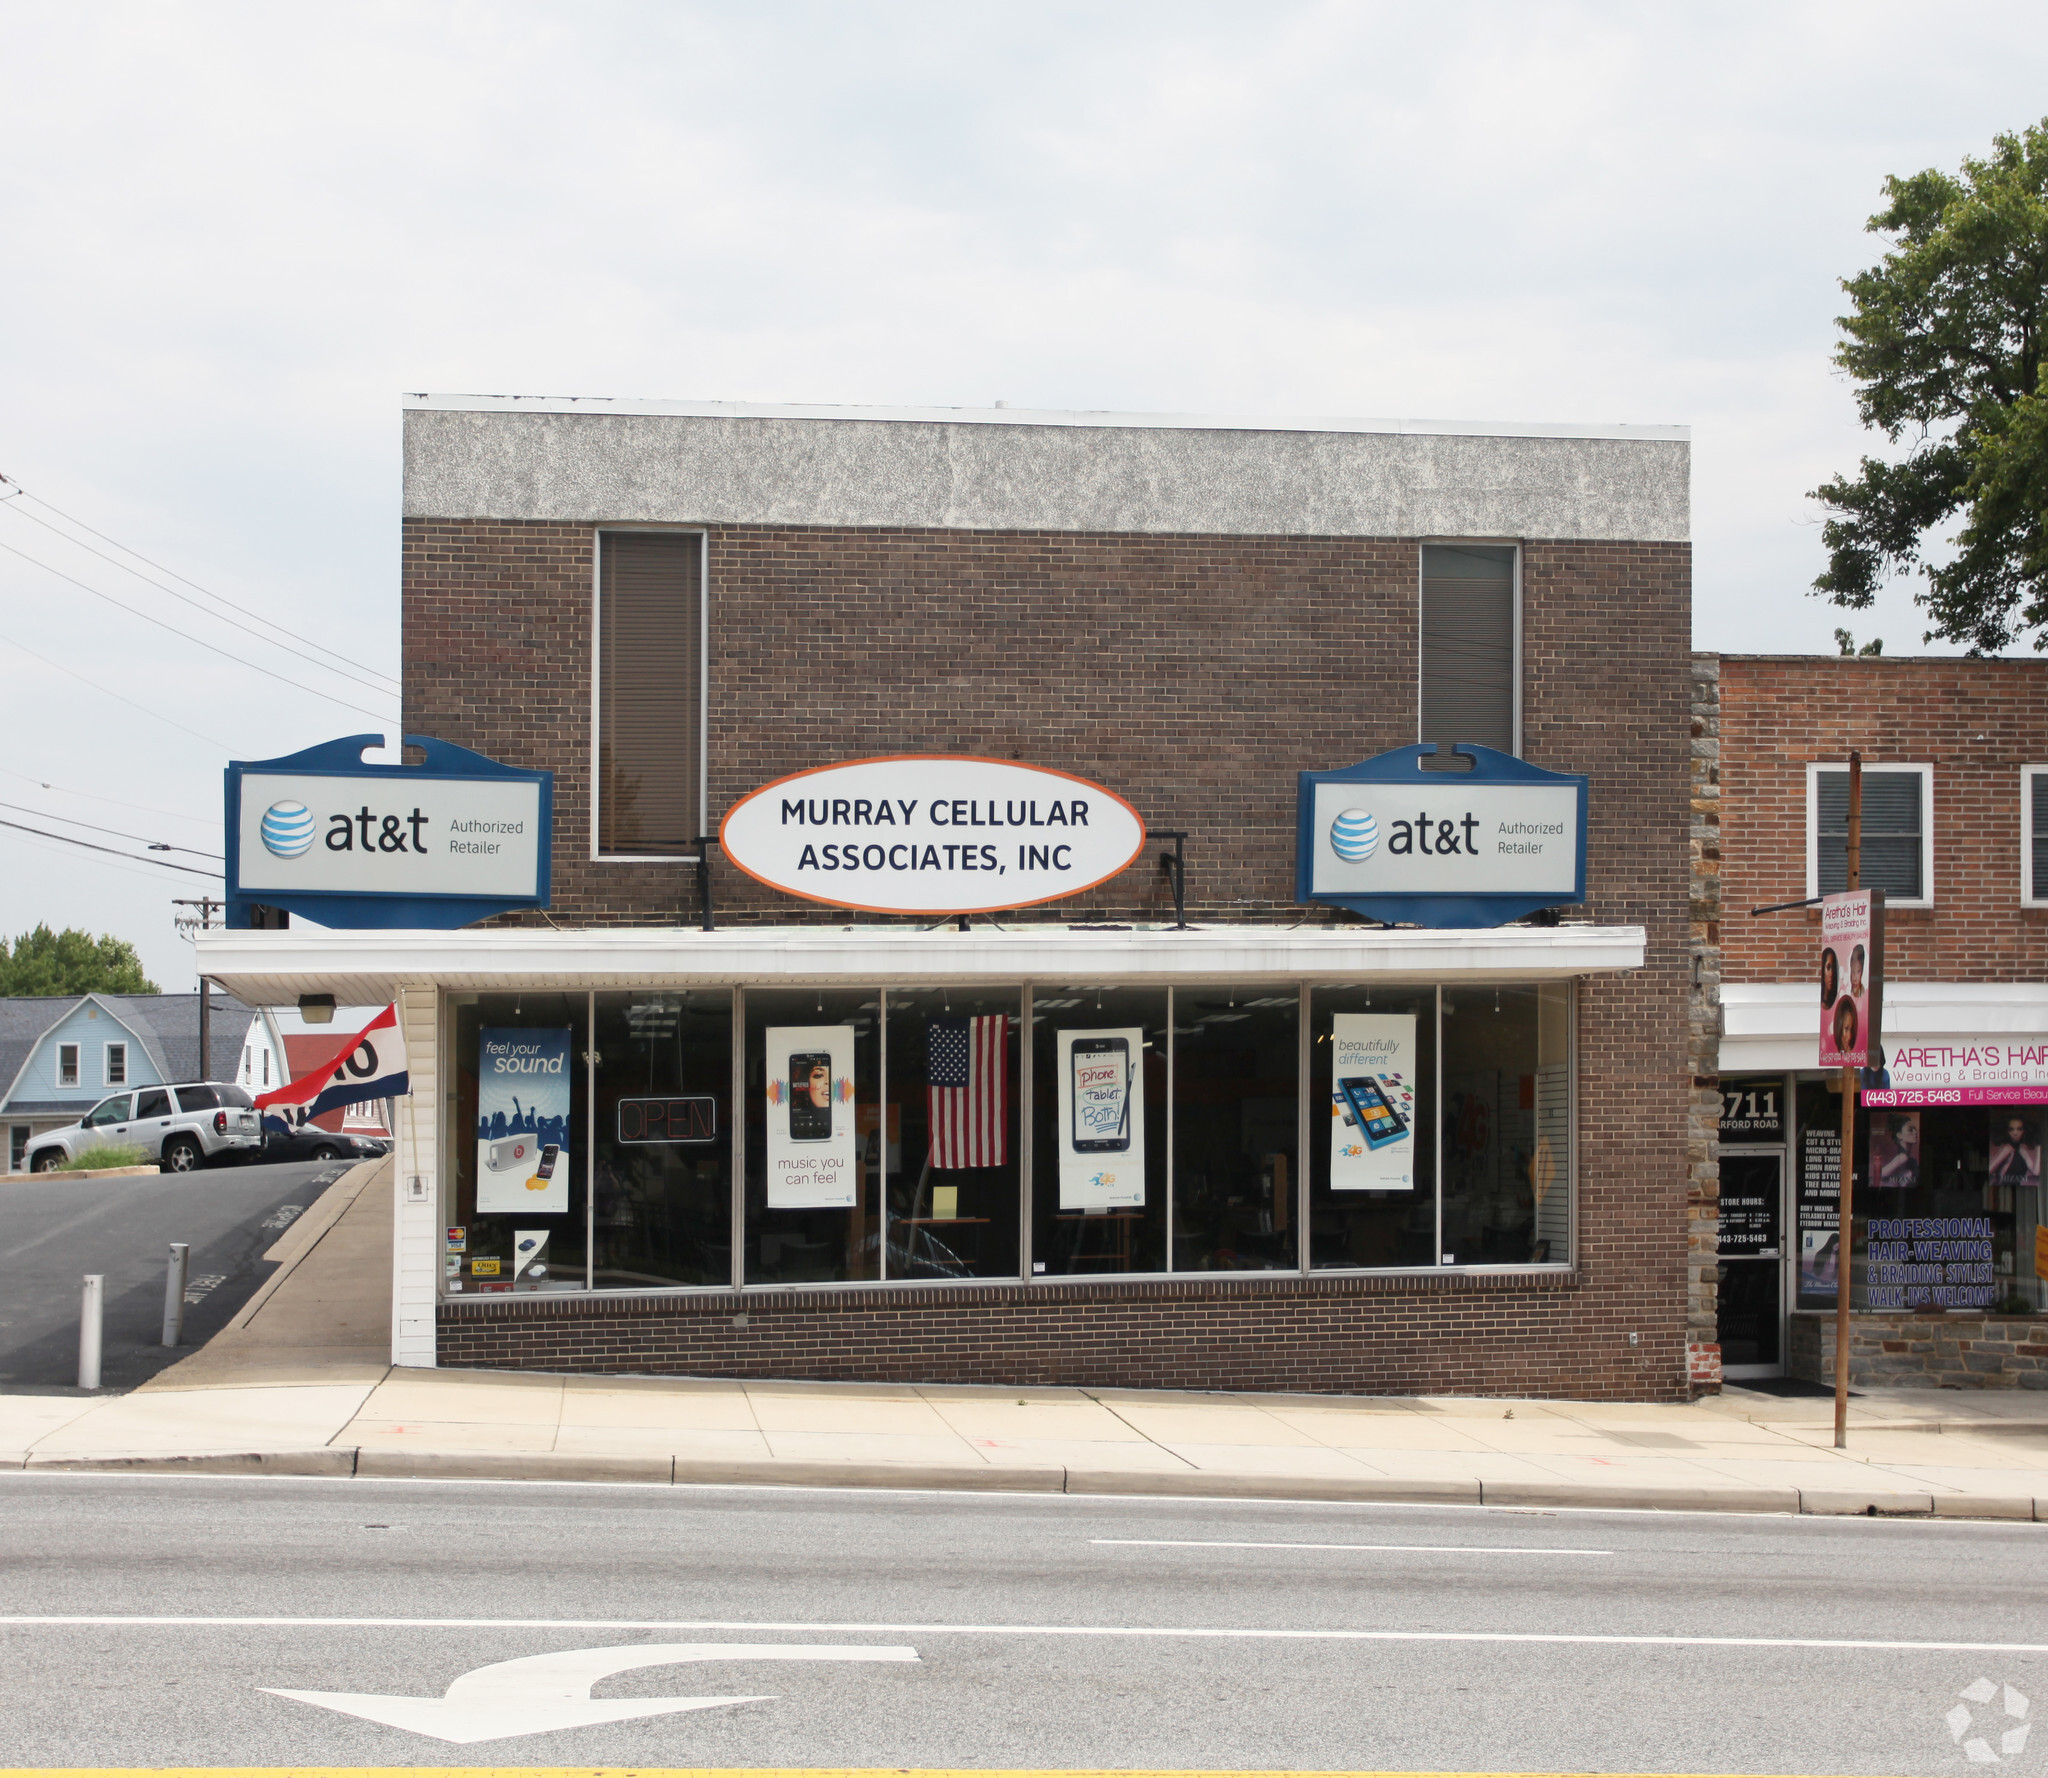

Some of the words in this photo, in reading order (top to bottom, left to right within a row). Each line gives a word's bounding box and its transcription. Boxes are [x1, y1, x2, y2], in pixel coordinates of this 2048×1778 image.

[781, 799, 917, 826] MURRAY
[929, 799, 1089, 826] CELLULAR
[325, 806, 429, 854] at&t
[450, 819, 524, 834] Authorized
[1388, 812, 1480, 855] at&t
[1498, 822, 1563, 835] Authorized
[450, 840, 501, 854] Retailer
[1498, 841, 1543, 855] Retailer
[797, 844, 1006, 875] ASSOCIATES,
[1019, 844, 1072, 871] INC
[1825, 904, 1851, 920] Aretha's
[1852, 902, 1867, 917] Hair
[485, 1041, 510, 1054] feel
[510, 1044, 541, 1058] your
[1338, 1039, 1400, 1055] beautifully
[494, 1052, 565, 1074] sound
[1338, 1052, 1388, 1065] different
[1893, 1046, 2000, 1068] ARETHA'S
[1892, 1069, 1950, 1083] Weaving
[1957, 1071, 1966, 1081] &
[1973, 1068, 2029, 1082] Braiding
[2035, 1068, 2048, 1079] In
[1866, 1090, 1897, 1106] (443)
[1900, 1090, 1961, 1104] 725-5463
[1968, 1089, 1984, 1100] Full
[1986, 1089, 2021, 1100] Service
[622, 1101, 711, 1138] OPEN
[1718, 1120, 1751, 1129] RFORD
[1753, 1119, 1779, 1129] ROAD
[1806, 1138, 1818, 1146] CUT
[1820, 1138, 1825, 1146] &
[1826, 1138, 1842, 1146] STYL
[778, 1155, 817, 1169] music
[820, 1158, 844, 1171] you
[1805, 1155, 1822, 1163] LONG
[1824, 1155, 1841, 1163] TWIS
[1805, 1163, 1823, 1171] CORN
[785, 1174, 810, 1185] can
[813, 1171, 837, 1184] feel
[1804, 1172, 1820, 1180] KIDS
[1804, 1189, 1818, 1197] AND
[1821, 1181, 1840, 1189] BRAID
[1720, 1198, 1740, 1206] STORE
[1741, 1198, 1765, 1206] HOURS:
[1867, 1217, 1994, 1239] PROFESSIONAL
[1867, 1240, 1993, 1261] HAIR-WEAVING
[1867, 1264, 1878, 1284] &
[1881, 1263, 1943, 1284] BRAIDING
[1946, 1263, 1994, 1284] STYLIST
[1867, 1286, 1930, 1307] WALK-INS
[1931, 1286, 1995, 1307] WELCOME
